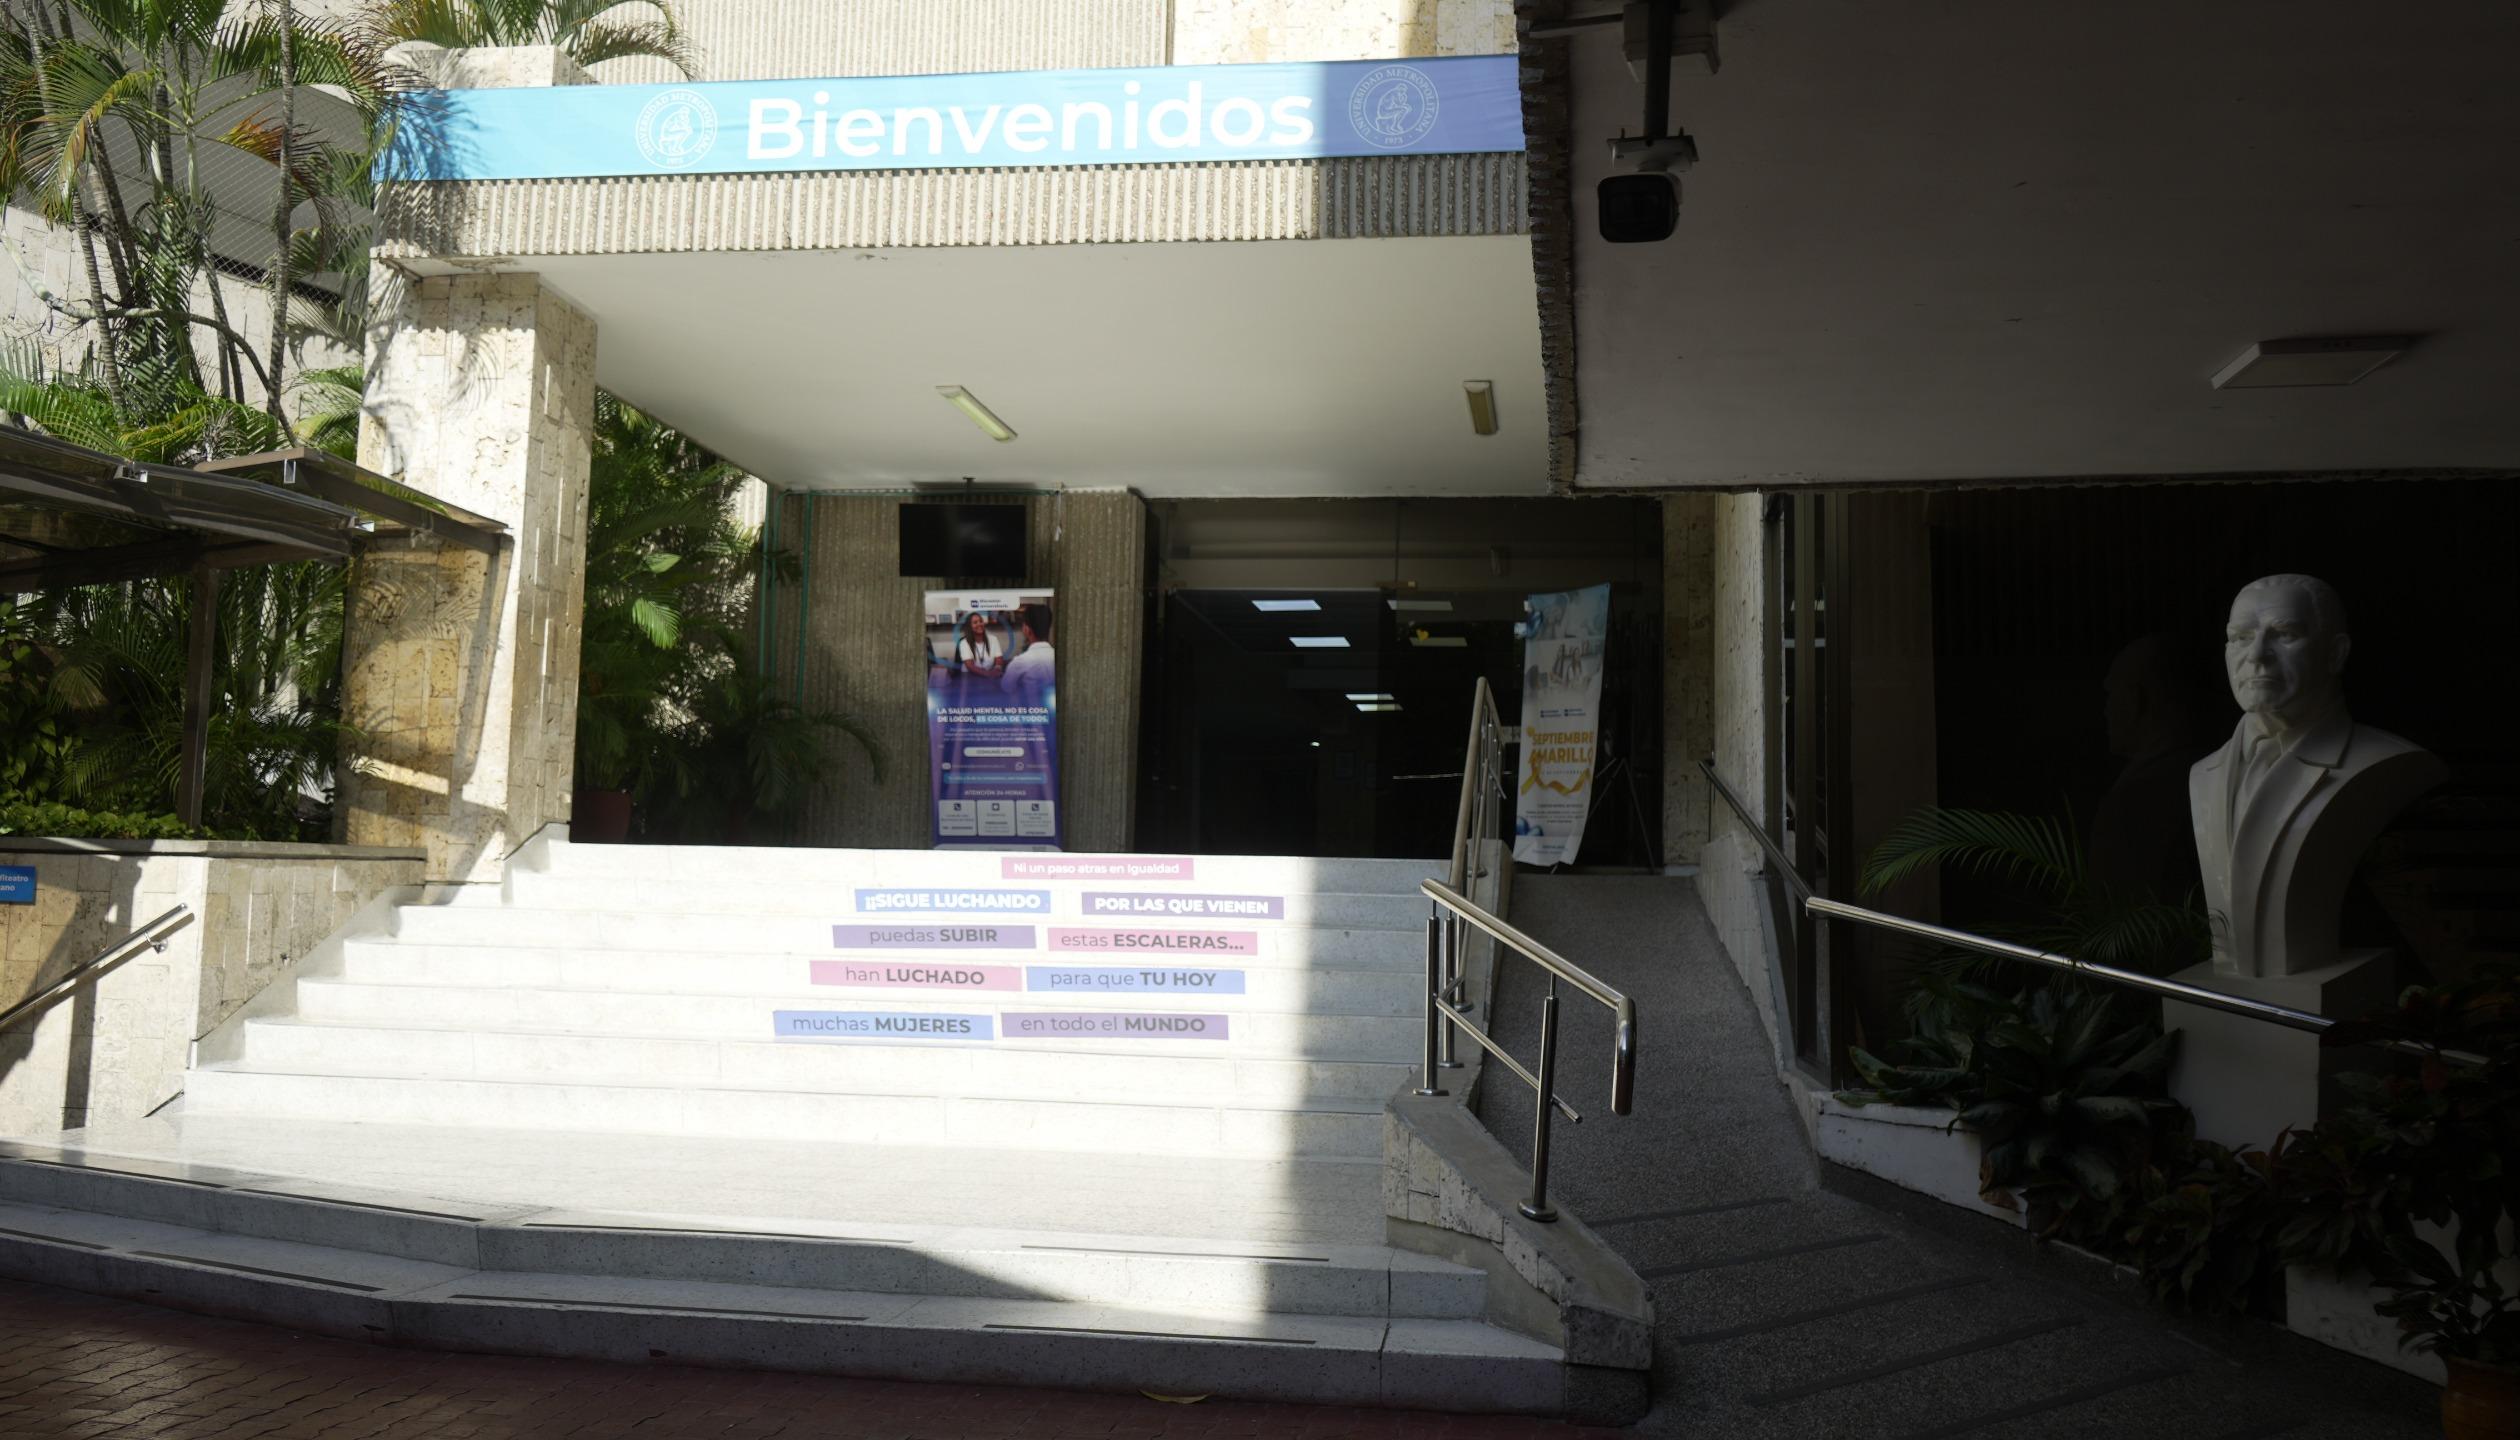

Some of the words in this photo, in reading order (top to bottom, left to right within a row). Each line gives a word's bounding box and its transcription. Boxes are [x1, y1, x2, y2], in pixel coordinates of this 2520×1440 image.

[747, 80, 1314, 160] Bienvenidos
[1014, 862, 1027, 873] Ni
[1029, 865, 1044, 873] un
[1048, 865, 1075, 876] paso
[1078, 864, 1107, 873] atras
[1109, 865, 1124, 873] en
[934, 893, 1041, 908] LUCHANDO
[1095, 898, 1130, 911] POR
[1133, 898, 1165, 912] LAS
[1168, 898, 1206, 913] QUE
[1208, 900, 1269, 914] VIENEN
[870, 929, 935, 945] puedas
[940, 929, 997, 942] SUBIR
[1061, 934, 1108, 947] estas
[1114, 933, 1244, 950] ESCALERAS...
[845, 966, 880, 982] han
[886, 968, 985, 985] LUCHADO
[1050, 972, 1092, 988] para
[1098, 972, 1135, 989] que
[1139, 972, 1166, 985] TU
[1173, 972, 1217, 987] HOY
[793, 1016, 869, 1031] muchas
[874, 1017, 972, 1033] MUJERES
[1020, 1019, 1045, 1031] en
[1050, 1016, 1096, 1031] todo
[1102, 1017, 1118, 1031] el
[1124, 1017, 1206, 1032] MUNDO
